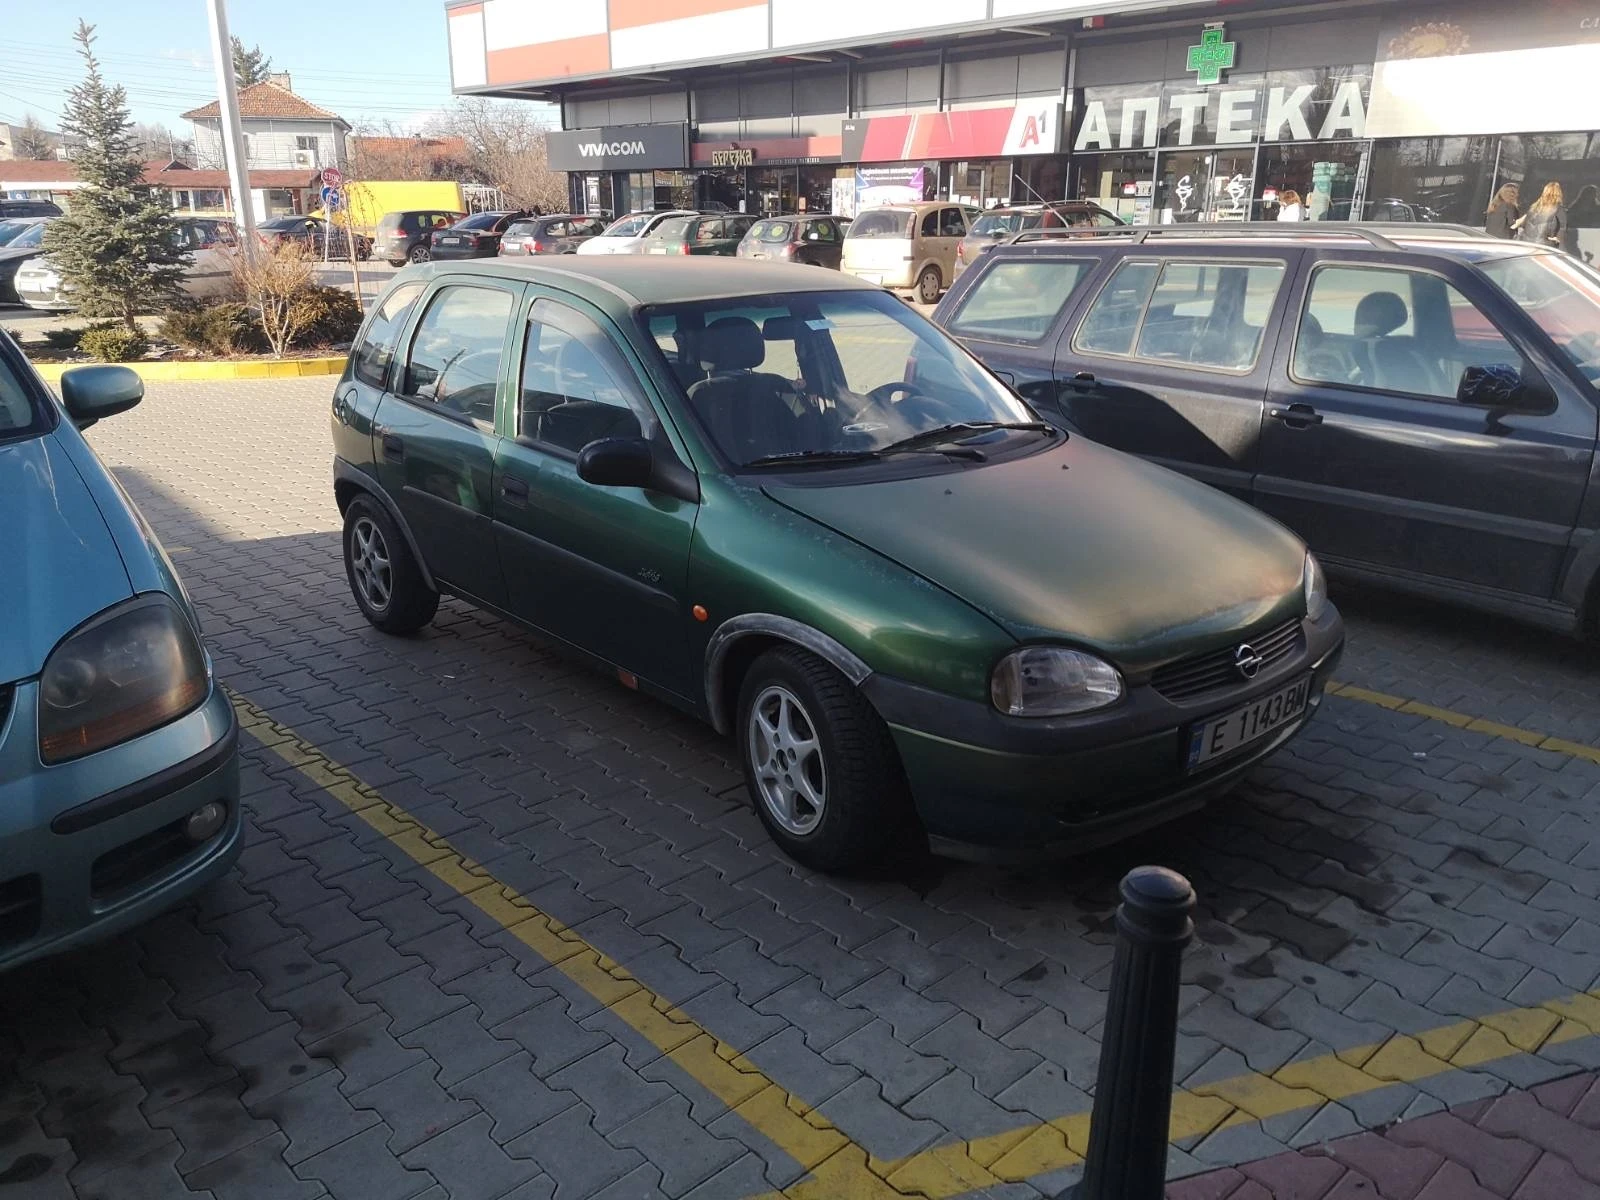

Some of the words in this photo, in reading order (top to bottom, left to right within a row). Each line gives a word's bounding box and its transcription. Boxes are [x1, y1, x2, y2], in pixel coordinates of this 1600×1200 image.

[1019, 109, 1048, 148] A1
[1074, 81, 1367, 152] АПТЕКА
[578, 141, 646, 157] VIVACOM
[324, 172, 340, 182] STOP
[1210, 720, 1228, 754] E
